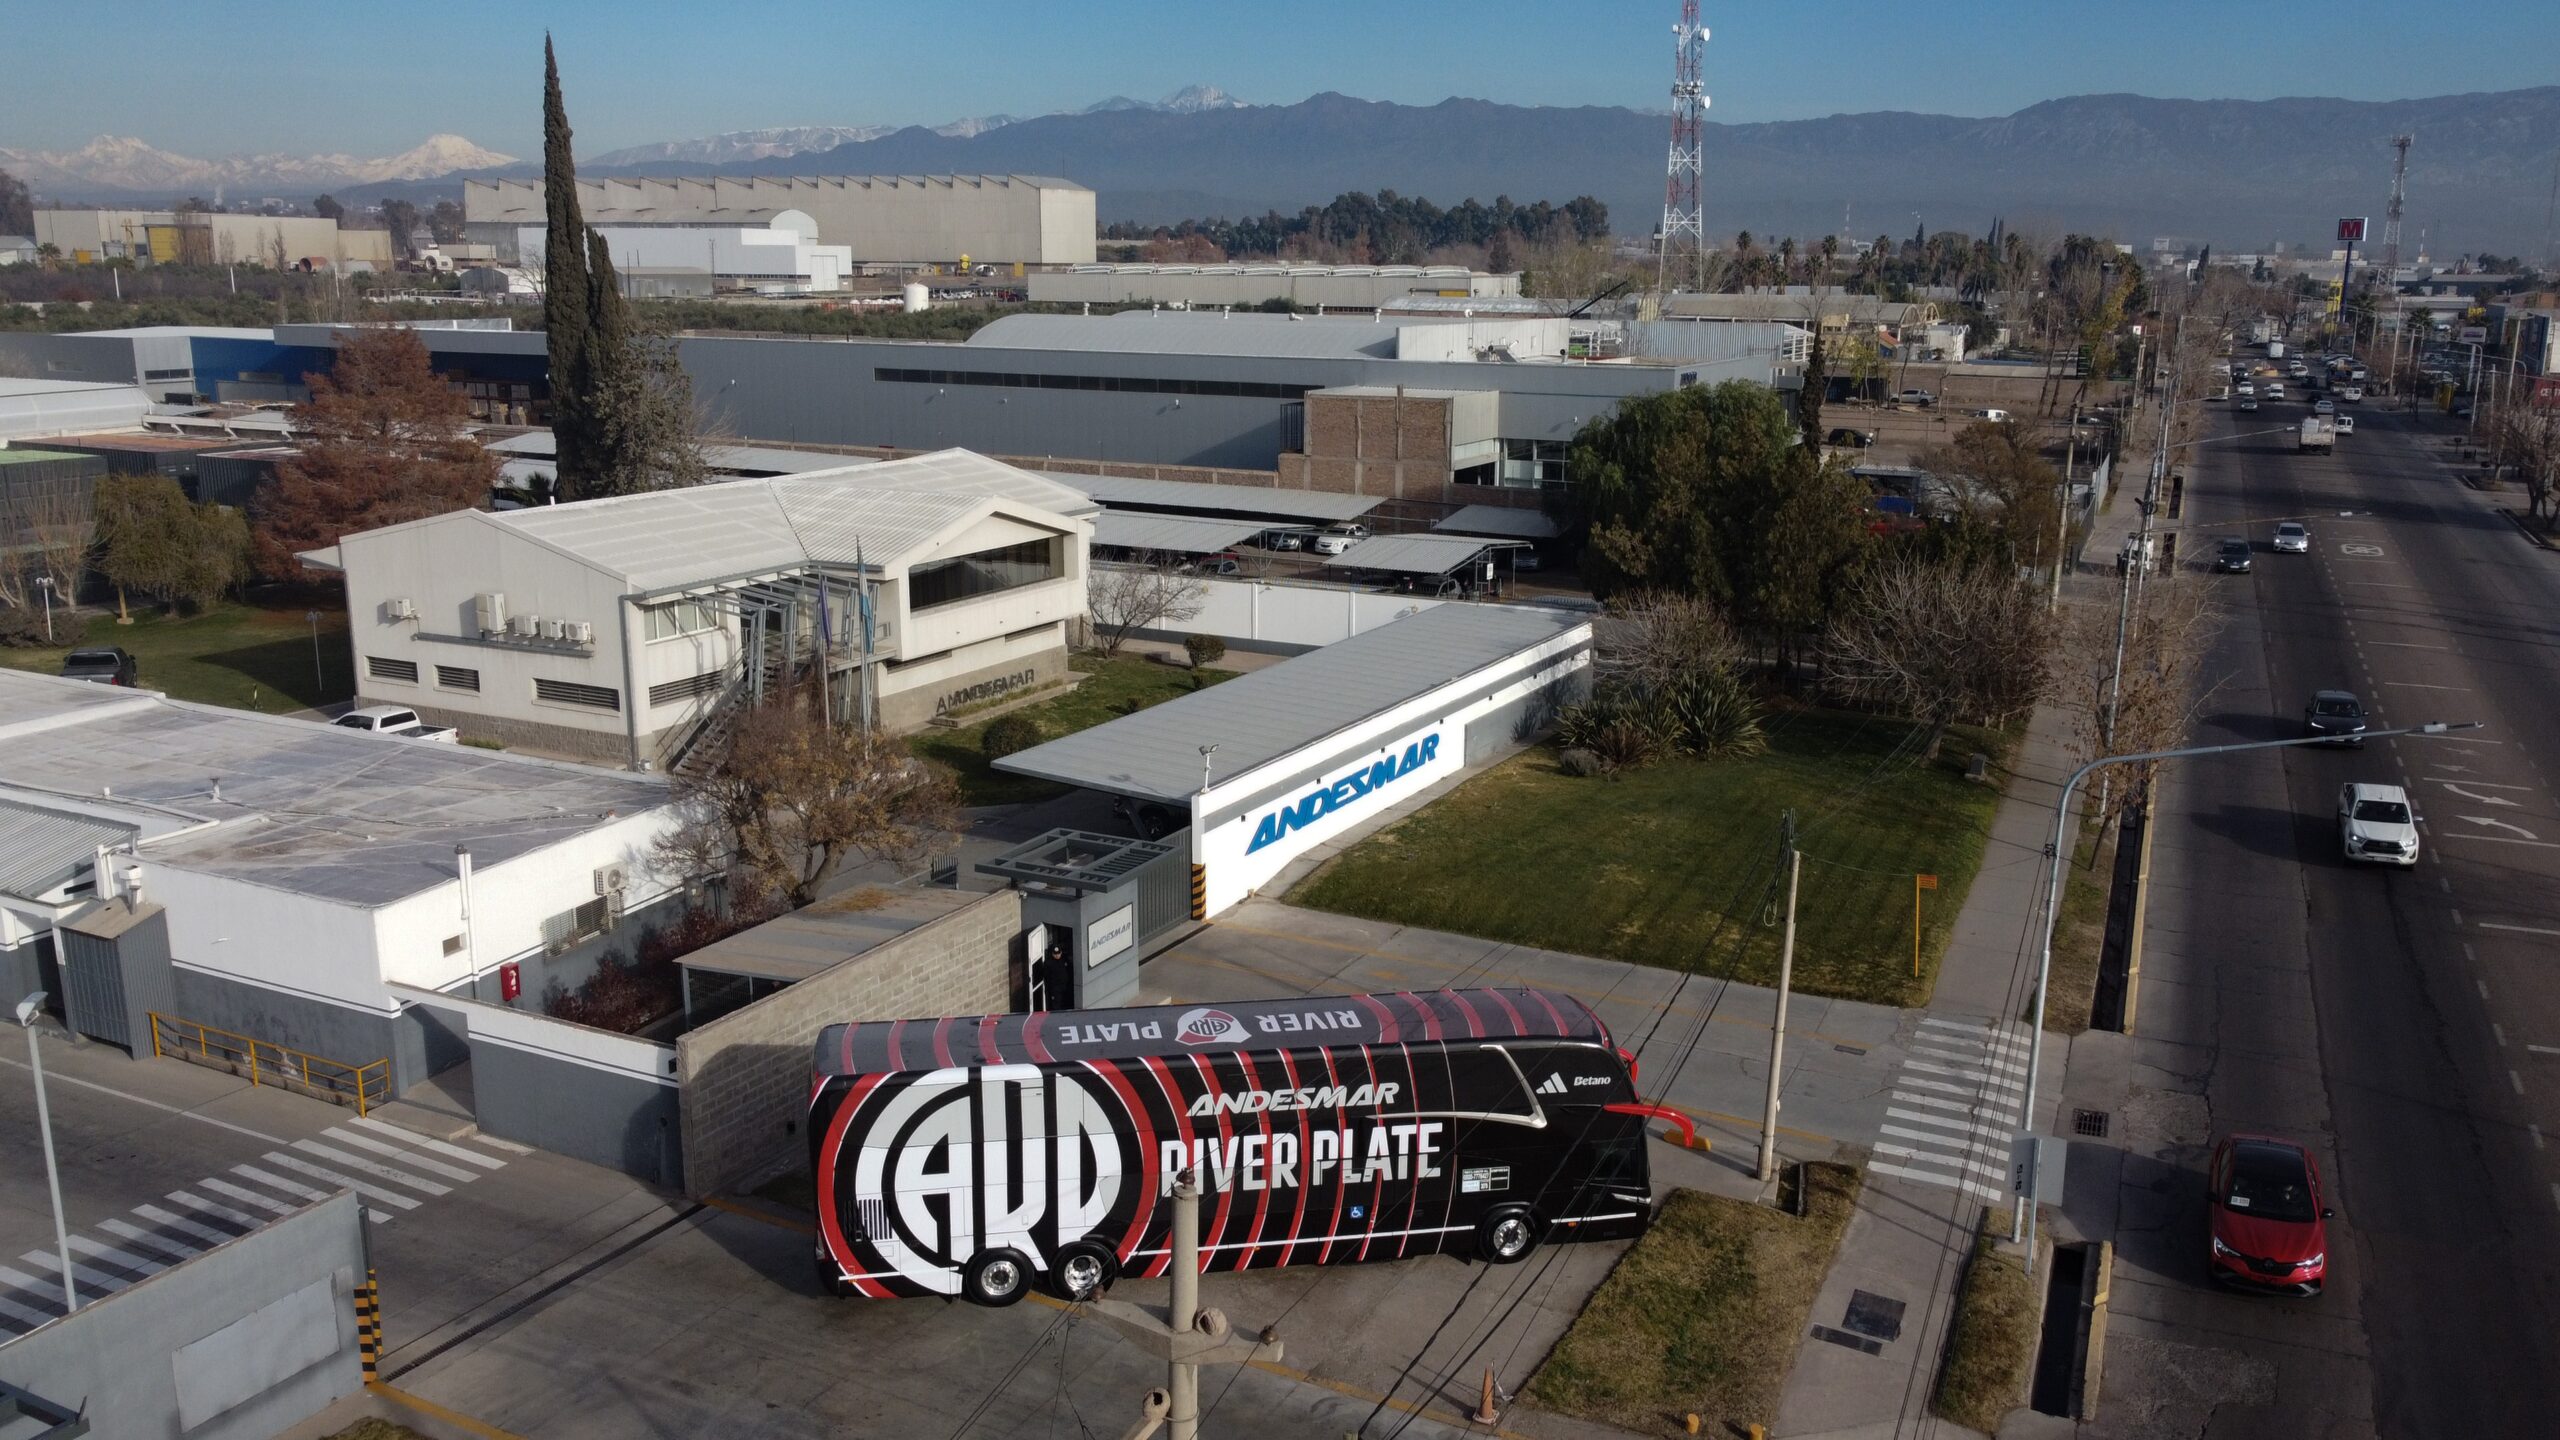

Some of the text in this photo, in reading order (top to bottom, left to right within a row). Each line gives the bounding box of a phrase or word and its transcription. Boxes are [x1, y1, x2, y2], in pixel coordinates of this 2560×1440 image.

[2339, 220, 2363, 239] M
[1244, 733, 1440, 856] ANDESMAR
[1091, 922, 1131, 950] ANDESMAR
[1059, 1010, 1362, 1044] RIVER PLATE
[1573, 1076, 1611, 1086] Betano
[1185, 1082, 1399, 1117] ANDESMAR
[1161, 1122, 1444, 1197] RIVER PLATE
